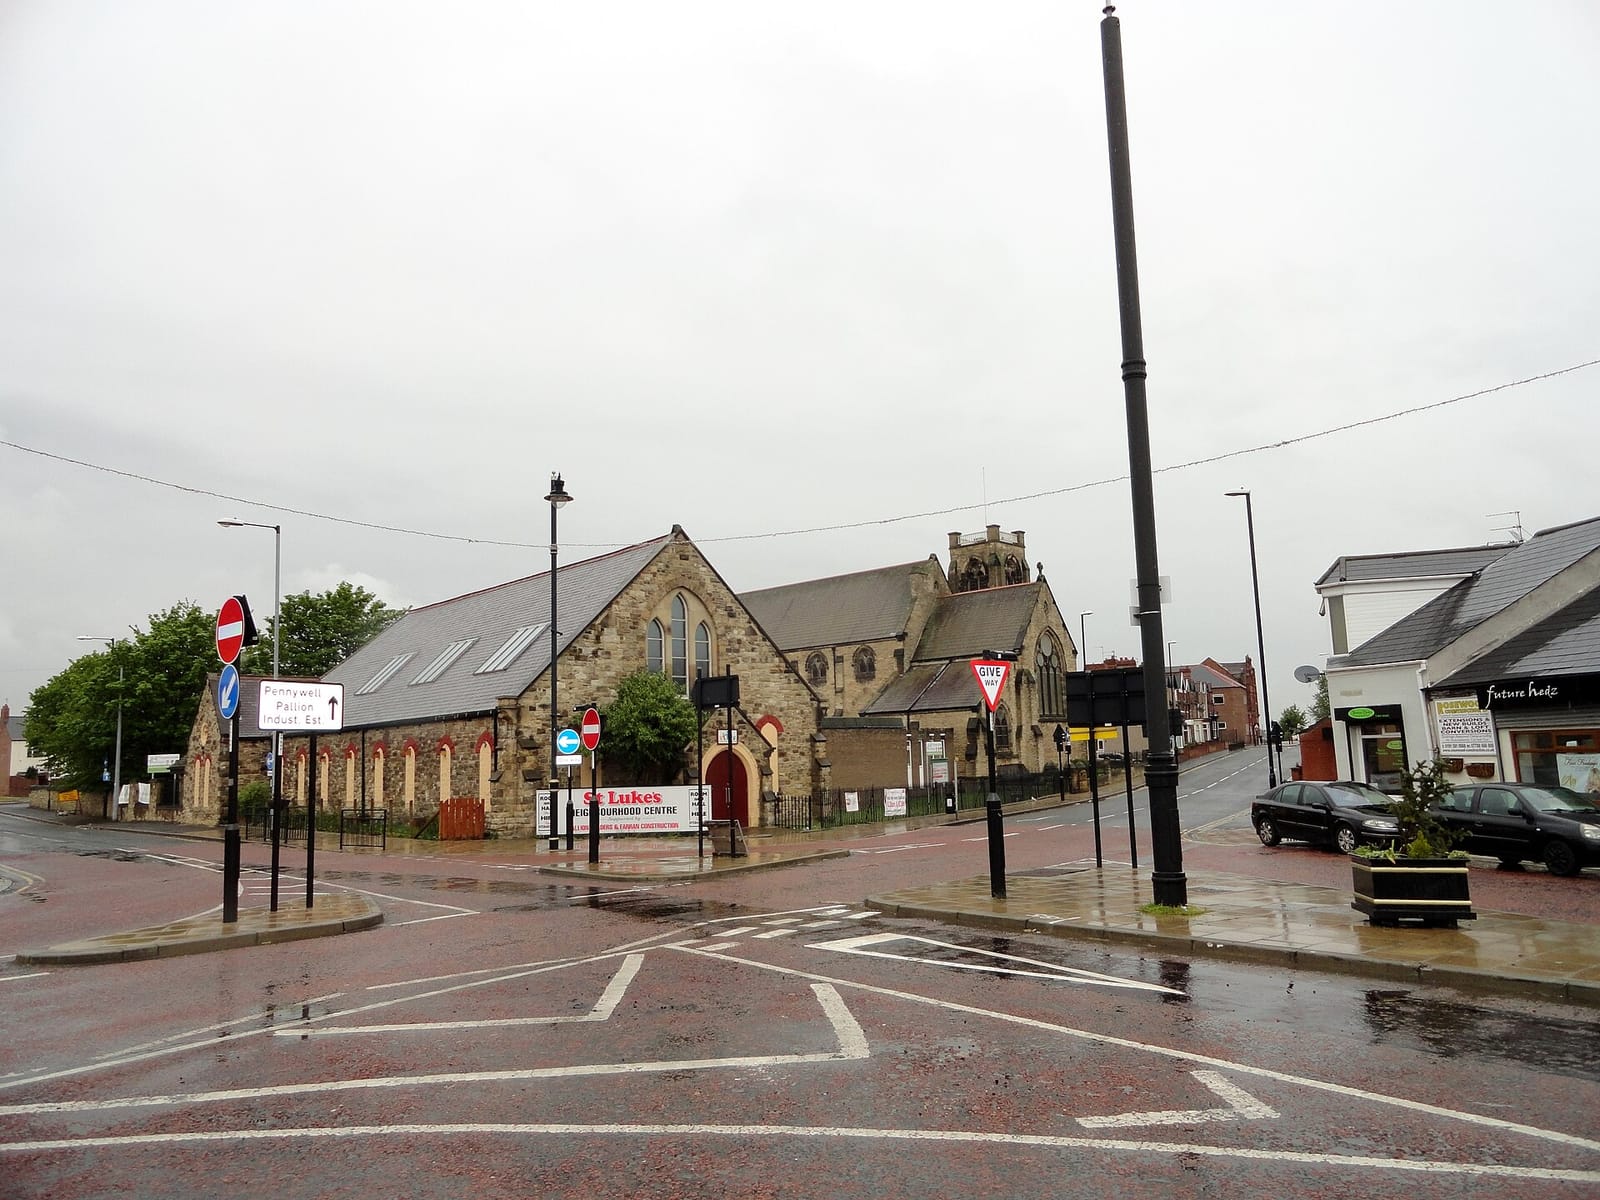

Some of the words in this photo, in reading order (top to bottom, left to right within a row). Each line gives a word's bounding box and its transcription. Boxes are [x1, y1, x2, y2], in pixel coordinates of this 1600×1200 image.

[979, 666, 1001, 677] GIVE
[264, 685, 321, 698] Pennywell
[1485, 685, 1526, 709] future
[1528, 681, 1559, 699] hedz
[276, 701, 314, 712] Pallion
[583, 791, 603, 805] St
[608, 790, 663, 805] Luke's
[644, 806, 678, 815] CENTRE
